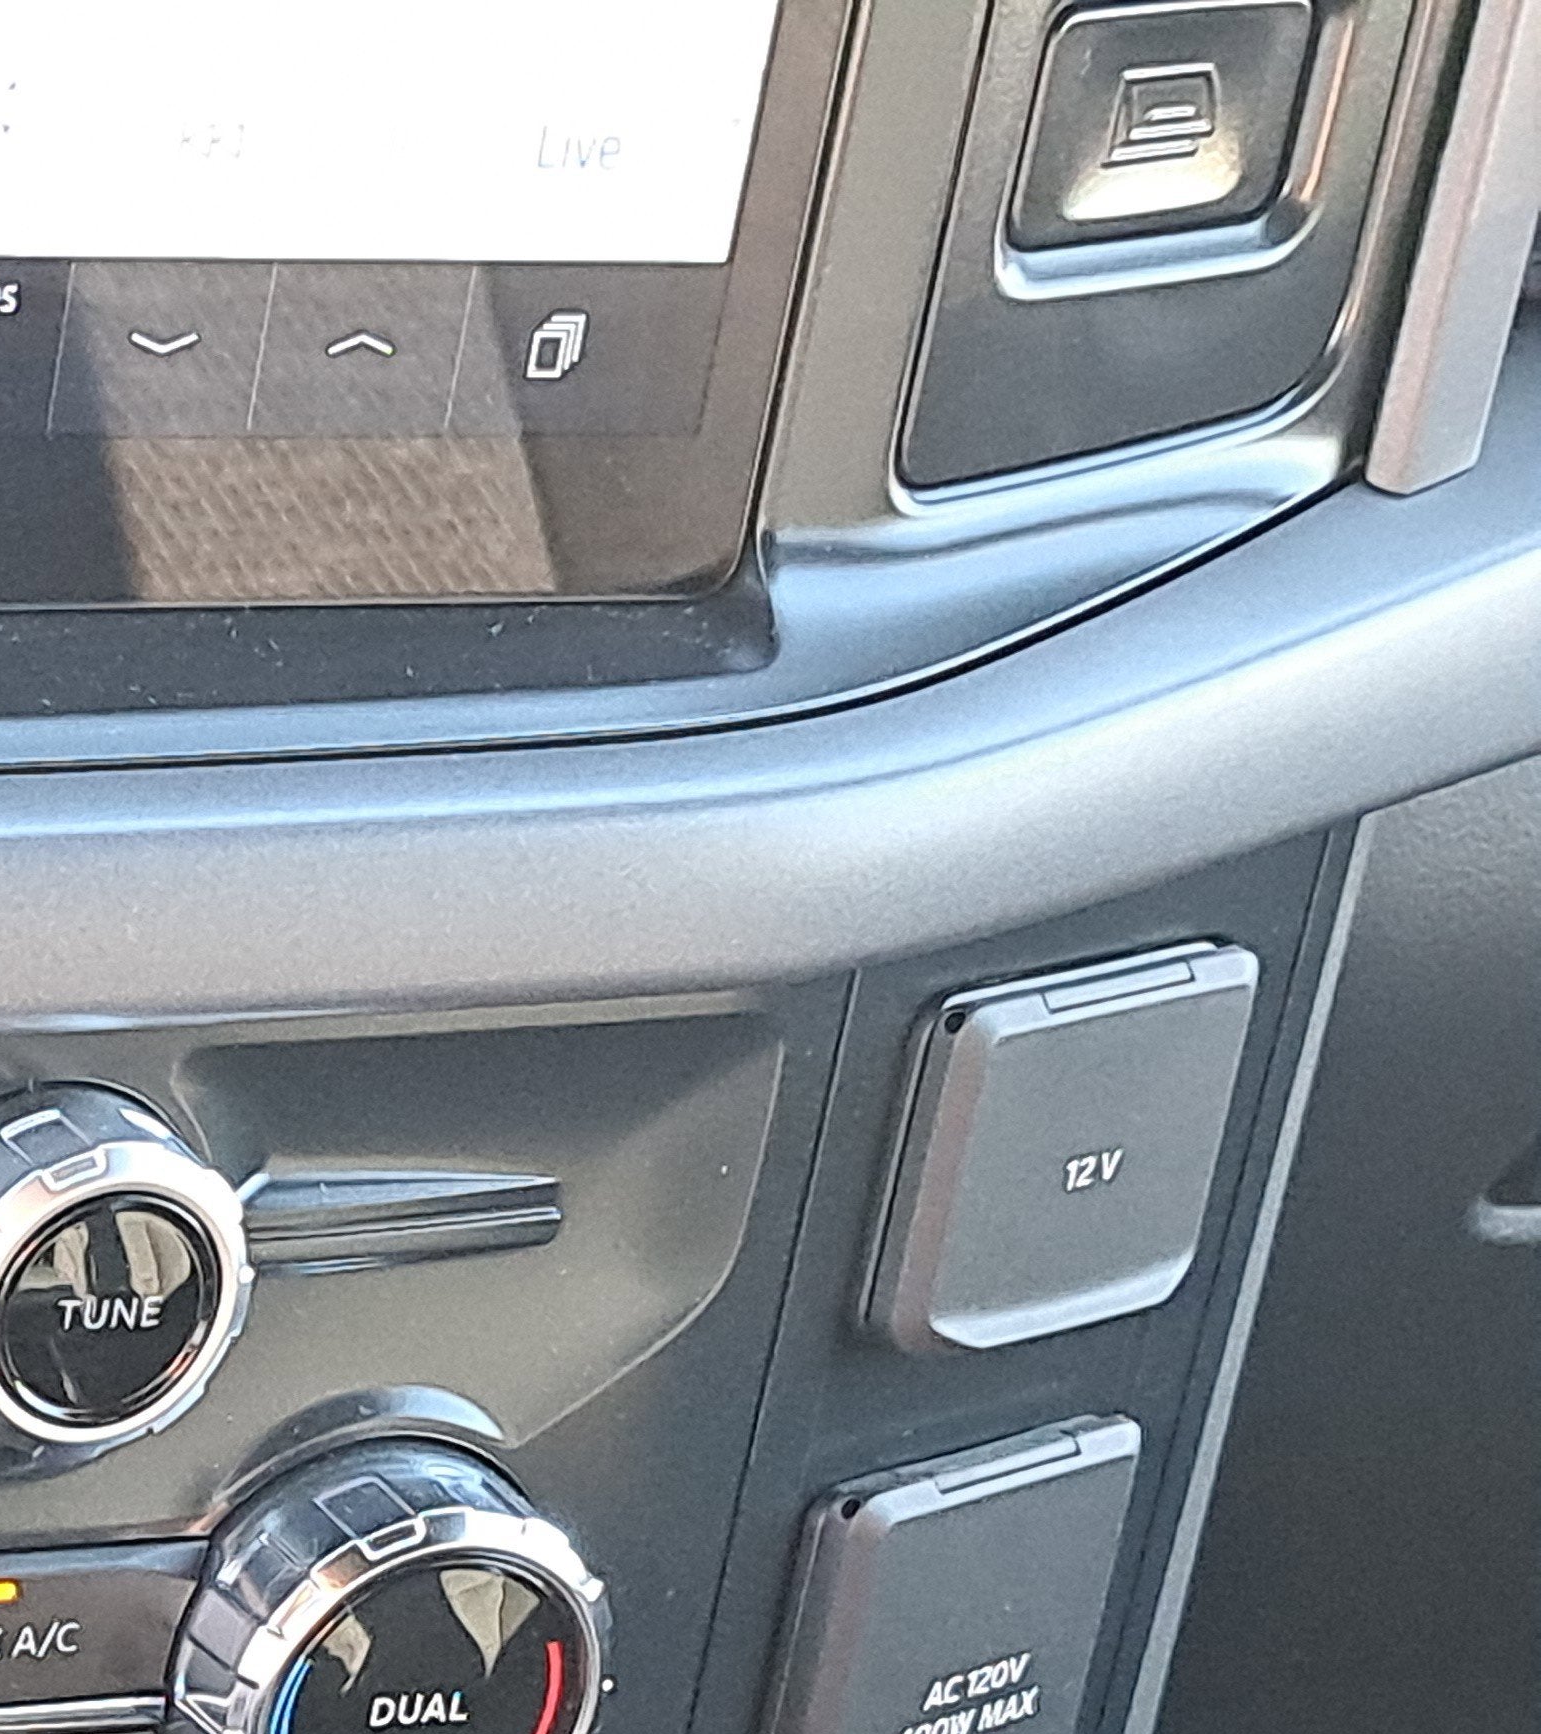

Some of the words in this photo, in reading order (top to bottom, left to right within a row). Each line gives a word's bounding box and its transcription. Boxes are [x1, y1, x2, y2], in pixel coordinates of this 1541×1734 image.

[537, 126, 623, 170] Live
[58, 1298, 163, 1331] TUNE
[12, 1622, 82, 1659] A/C
[922, 1676, 965, 1711] AC
[967, 1653, 1031, 1699] 120V
[369, 1692, 469, 1728] DUAL
[978, 1686, 1040, 1732] MAX
